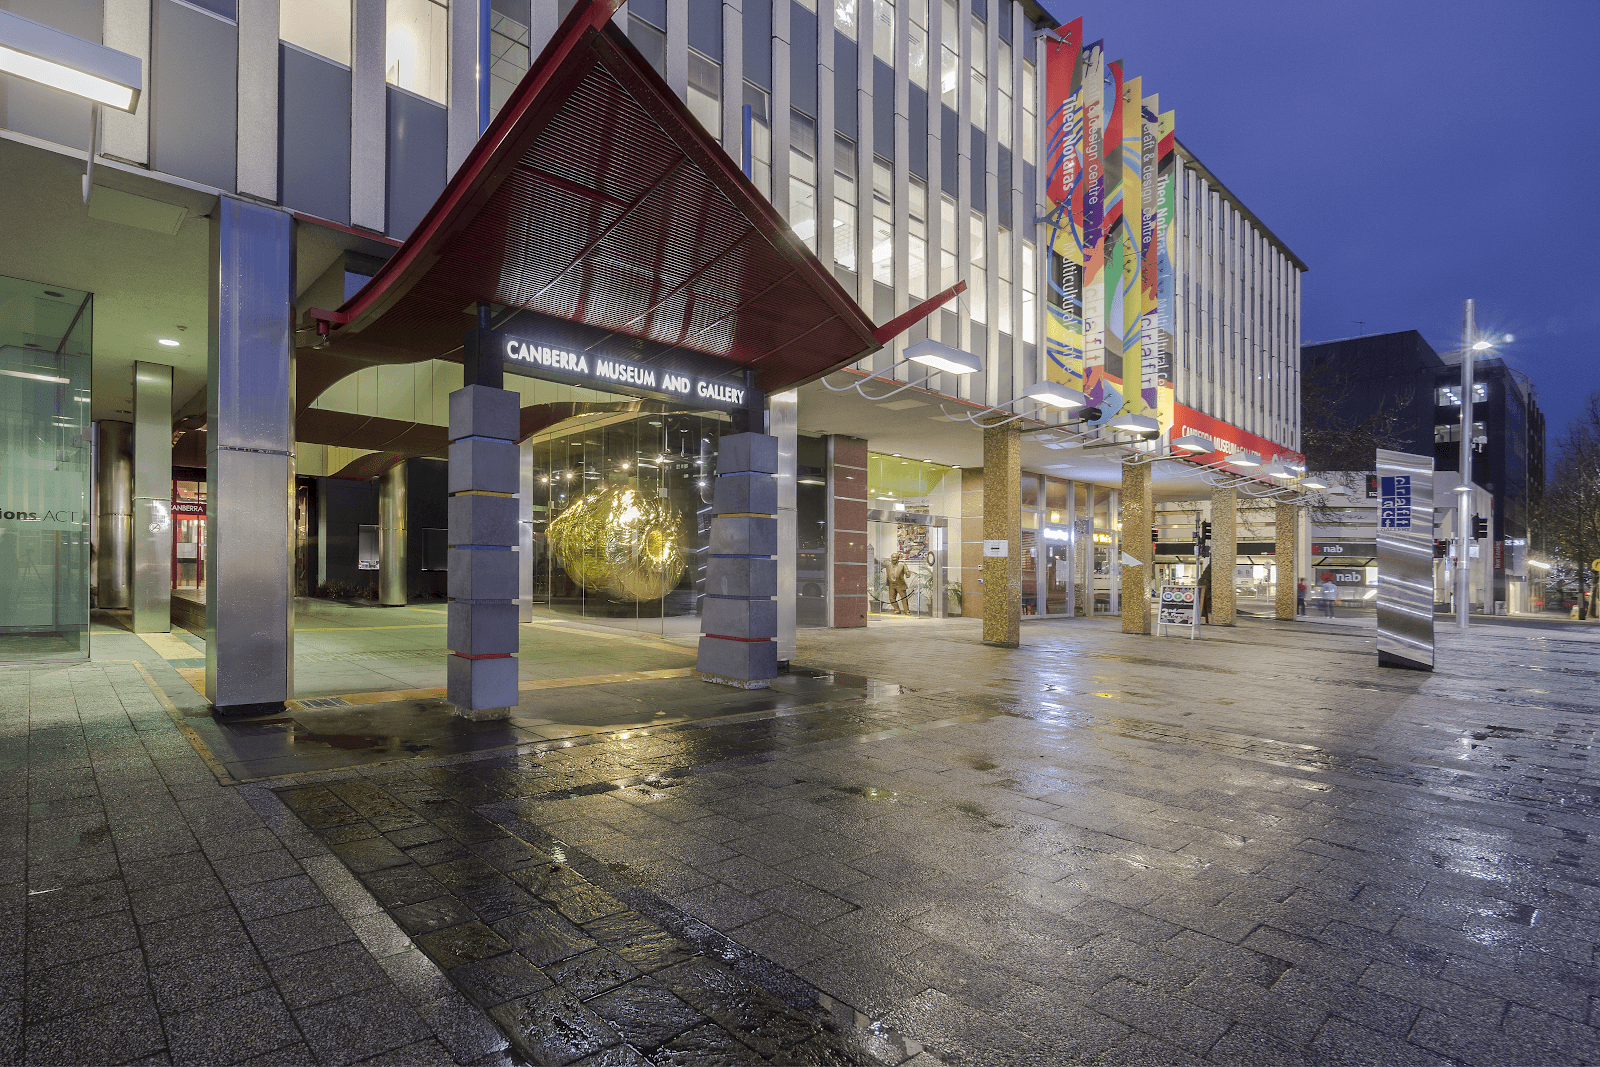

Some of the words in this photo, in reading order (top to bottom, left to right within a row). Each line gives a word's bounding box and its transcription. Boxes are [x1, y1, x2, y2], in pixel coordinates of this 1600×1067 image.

[1088, 72, 1100, 102] craft
[1062, 93, 1077, 132] Theo
[1088, 103, 1100, 114] &
[1086, 115, 1100, 161] design
[1142, 123, 1155, 151] craft
[1062, 134, 1076, 192] Notaras
[1142, 152, 1155, 163] &
[1088, 164, 1099, 205] centre
[1141, 165, 1155, 204] design
[1157, 173, 1169, 206] Theo
[1142, 207, 1154, 244] centre
[1157, 207, 1168, 256] Notaras
[1062, 242, 1078, 326] Multicultural
[506, 340, 588, 373] CANBERRA
[596, 359, 656, 387] MUSEUM
[662, 374, 690, 393] AND
[697, 381, 744, 404] GALLERY
[43, 510, 79, 523] ACT
[1323, 545, 1343, 553] nab
[1336, 572, 1361, 582] nab
